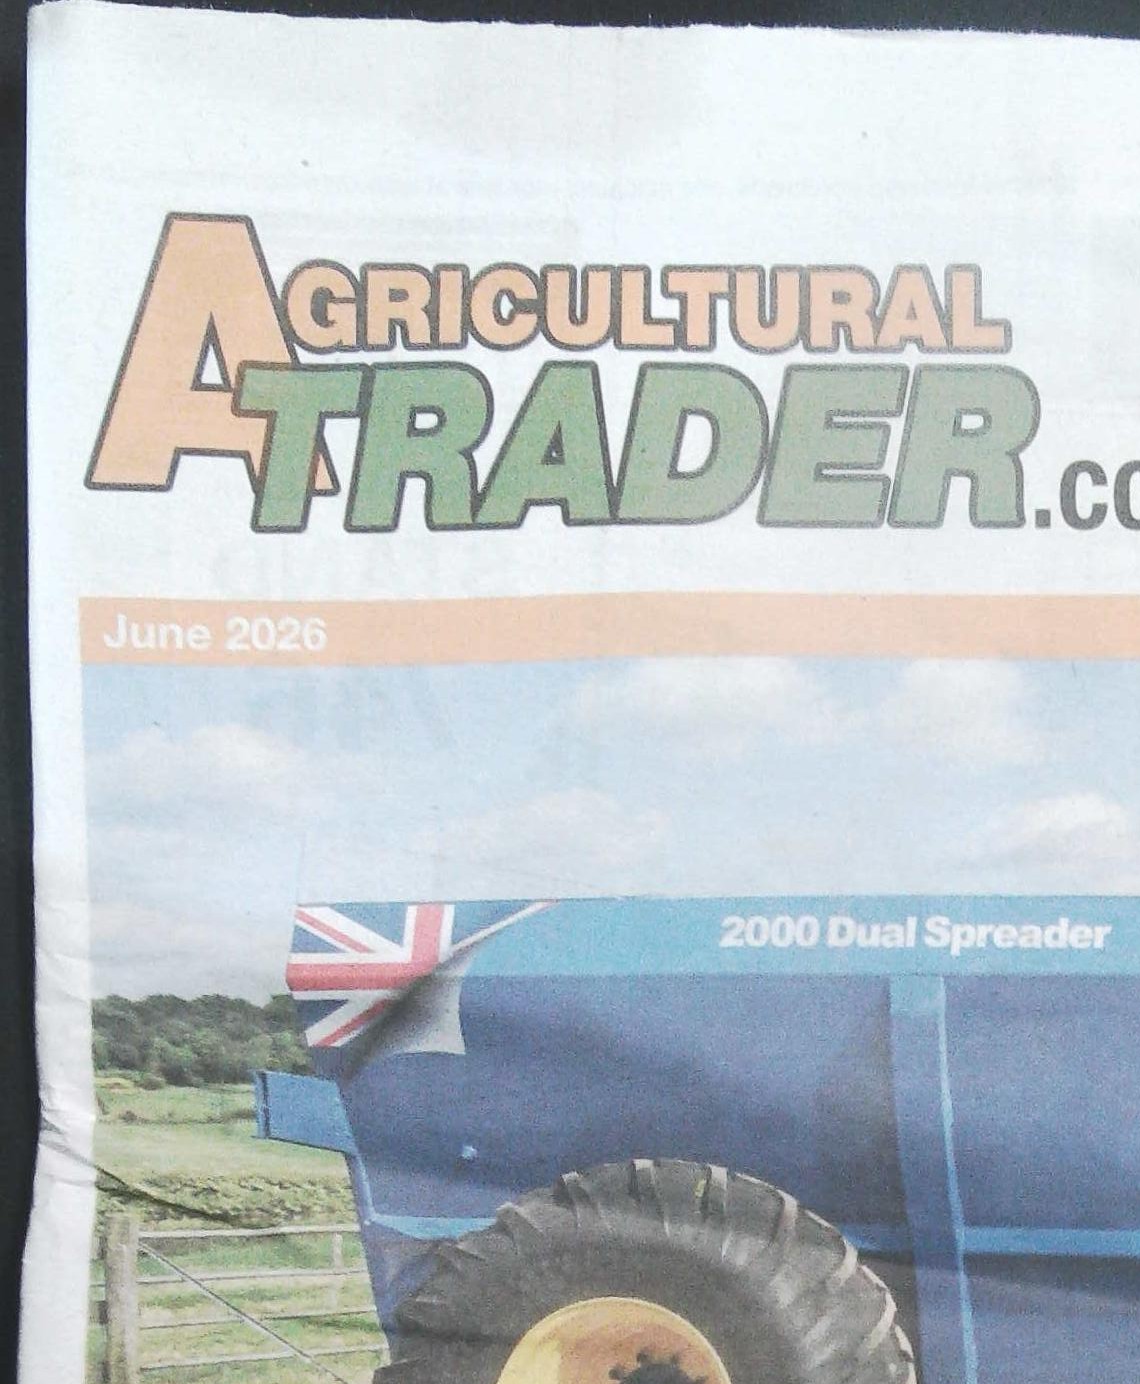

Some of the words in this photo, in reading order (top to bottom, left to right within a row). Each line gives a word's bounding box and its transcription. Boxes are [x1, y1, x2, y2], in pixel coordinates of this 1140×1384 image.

[84, 213, 1013, 495] AGRICULTURAL
[103, 614, 212, 653] June
[226, 616, 328, 652] 2026
[718, 915, 819, 949] 2000
[825, 915, 916, 949] Dual
[923, 916, 1112, 957] Spreader
